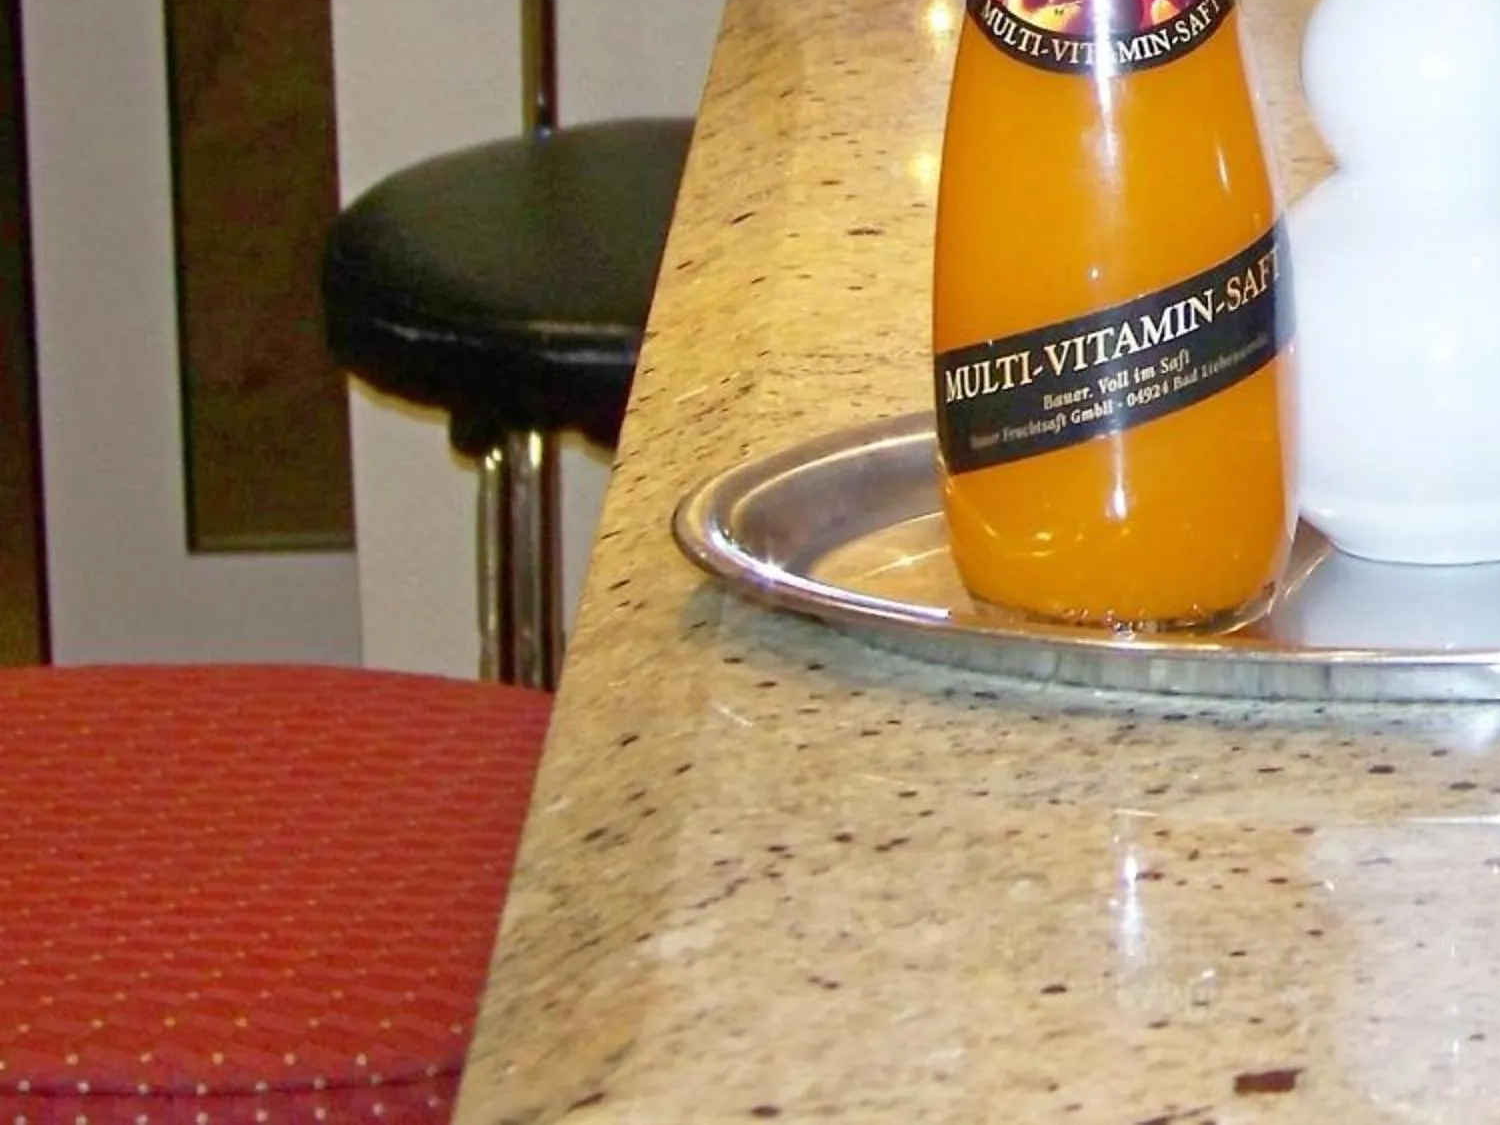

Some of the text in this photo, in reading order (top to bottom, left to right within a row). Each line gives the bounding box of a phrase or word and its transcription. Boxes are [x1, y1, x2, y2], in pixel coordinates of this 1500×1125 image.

[945, 243, 1280, 404] MULTI-VITAMIN-SAFT
[1098, 369, 1129, 394] Voll
[1134, 365, 1156, 384] im
[1160, 348, 1191, 375] Saft
[1070, 398, 1114, 424] GmbH
